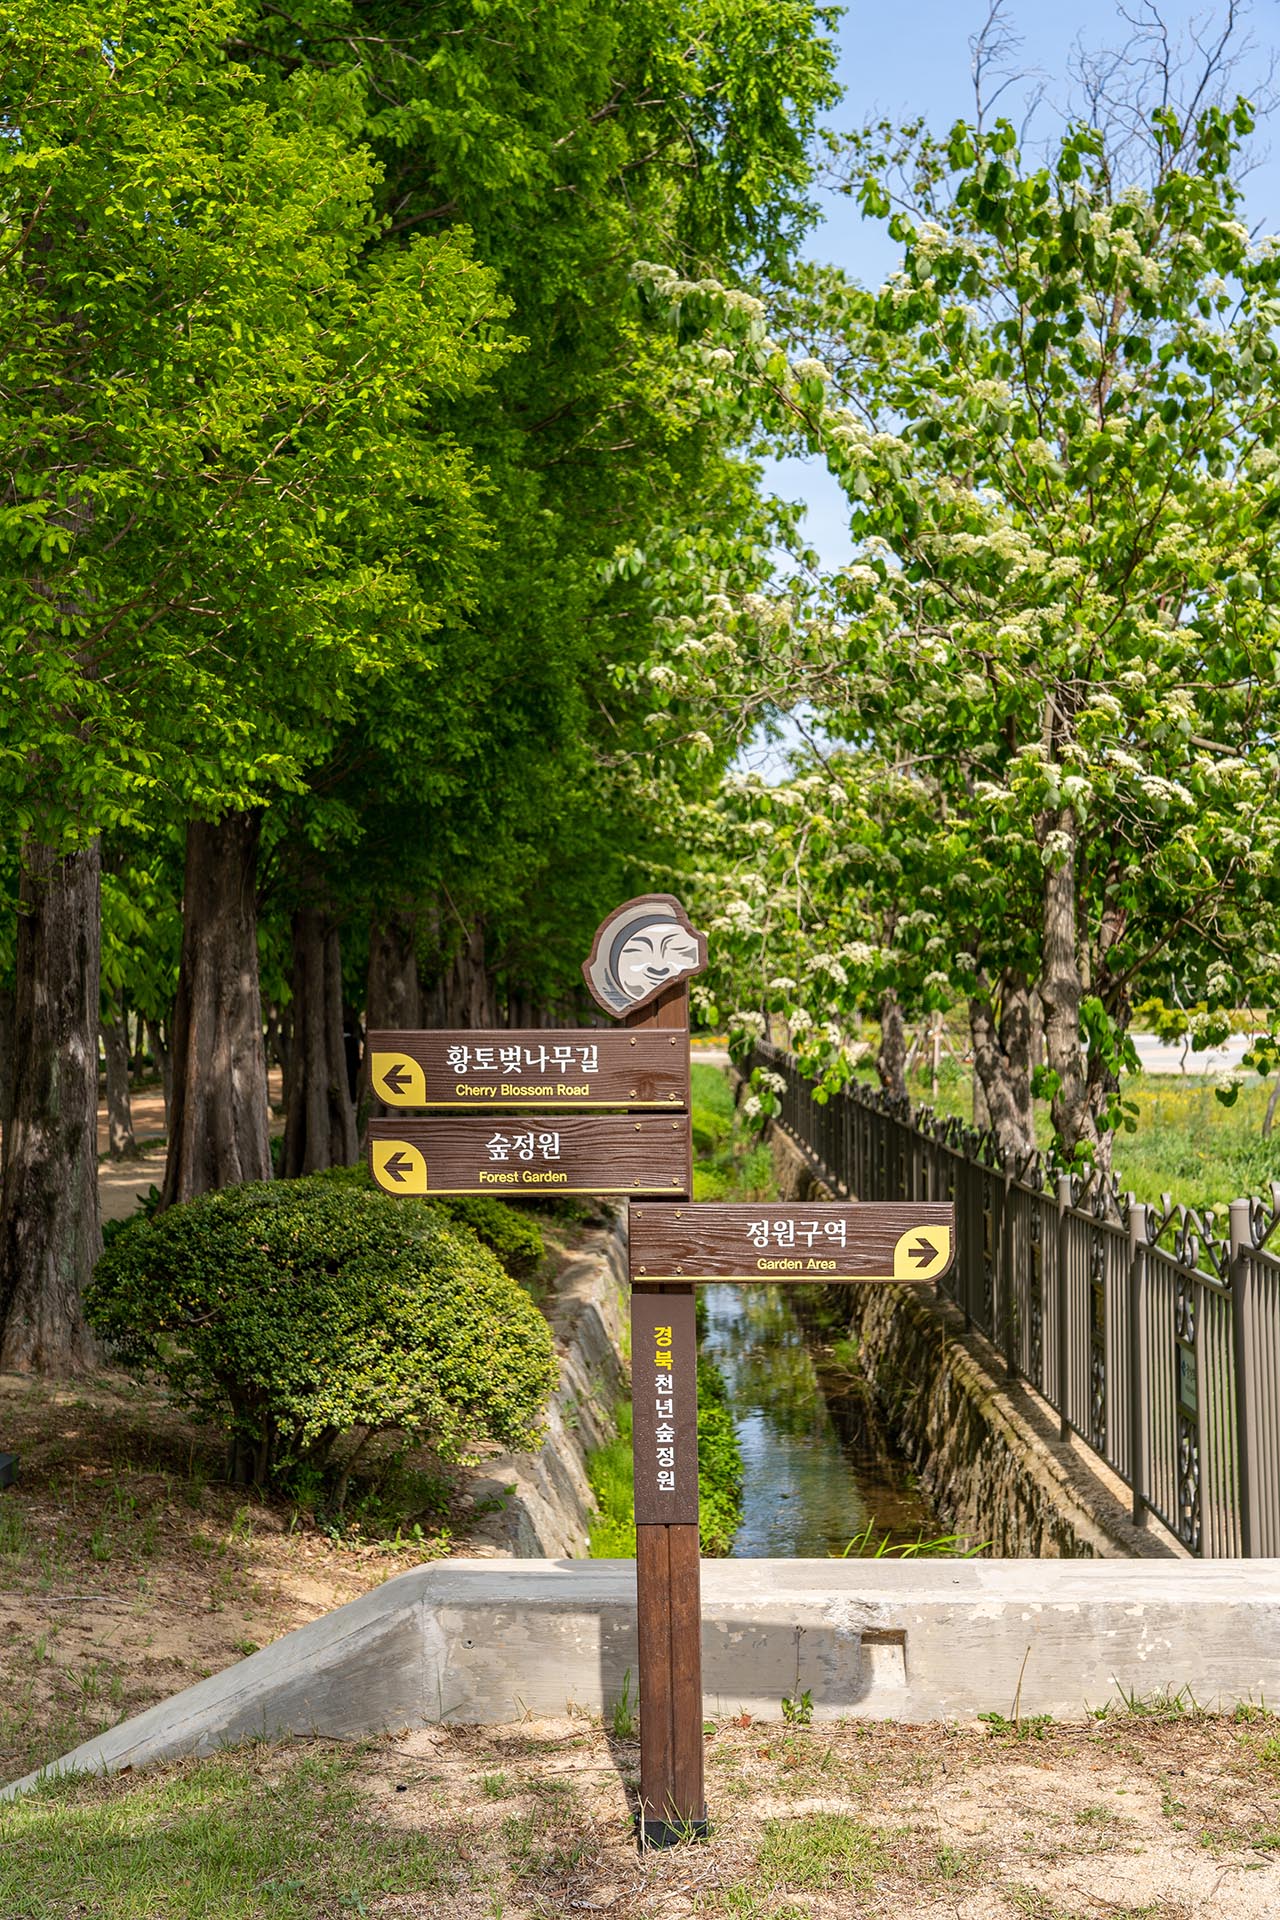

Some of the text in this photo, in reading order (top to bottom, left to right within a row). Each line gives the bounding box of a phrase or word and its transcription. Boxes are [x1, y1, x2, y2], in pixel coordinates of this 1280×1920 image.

[446, 1045, 599, 1074] 황토벚나무길
[455, 1084, 590, 1098] Cherry Blossom Road
[485, 1132, 561, 1161] 숲정원
[479, 1171, 568, 1183] Forest Garden
[746, 1219, 847, 1248] 정원구역
[757, 1258, 837, 1270] Garden Area
